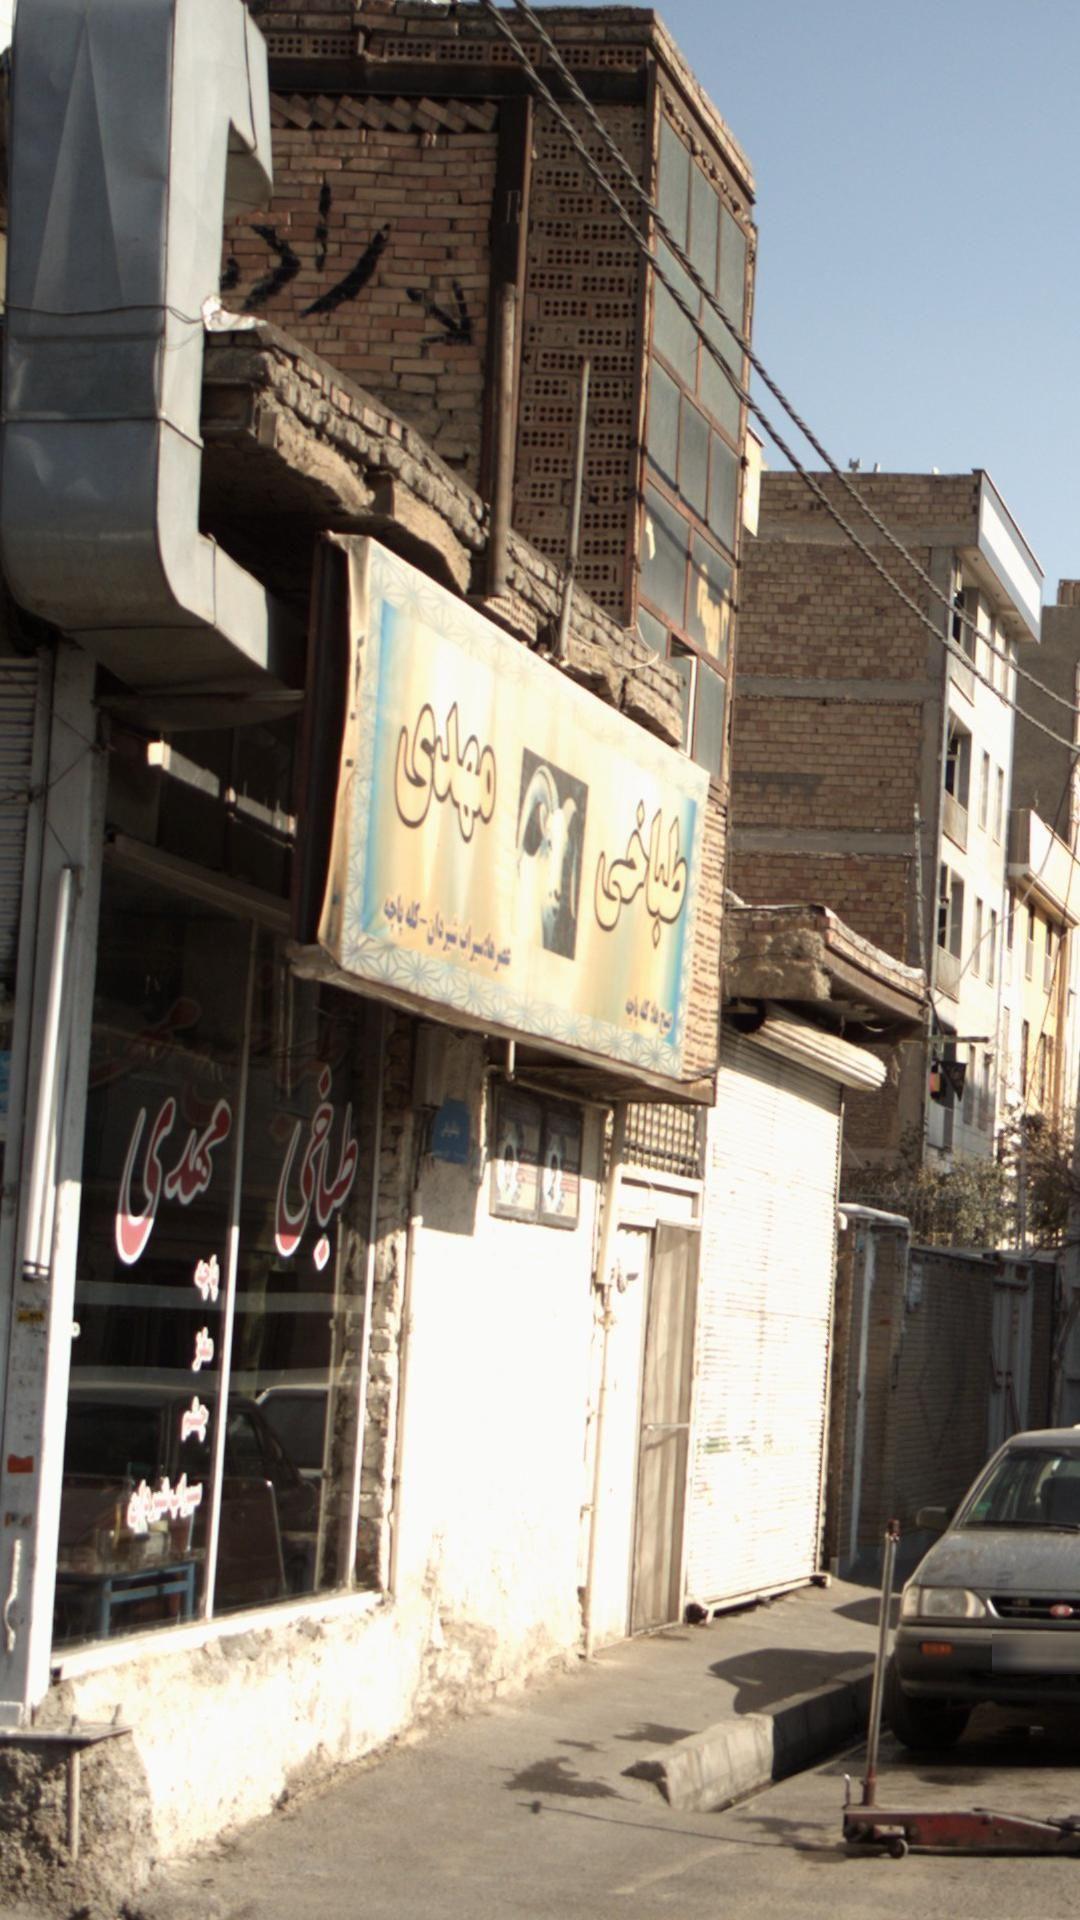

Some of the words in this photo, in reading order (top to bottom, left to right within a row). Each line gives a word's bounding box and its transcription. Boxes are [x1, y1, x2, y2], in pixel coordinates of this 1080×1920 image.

[394, 701, 497, 844] مهدی
[593, 799, 689, 949] طباخی
[115, 1096, 233, 1266] مهدی
[275, 1063, 359, 1272] طباخی
